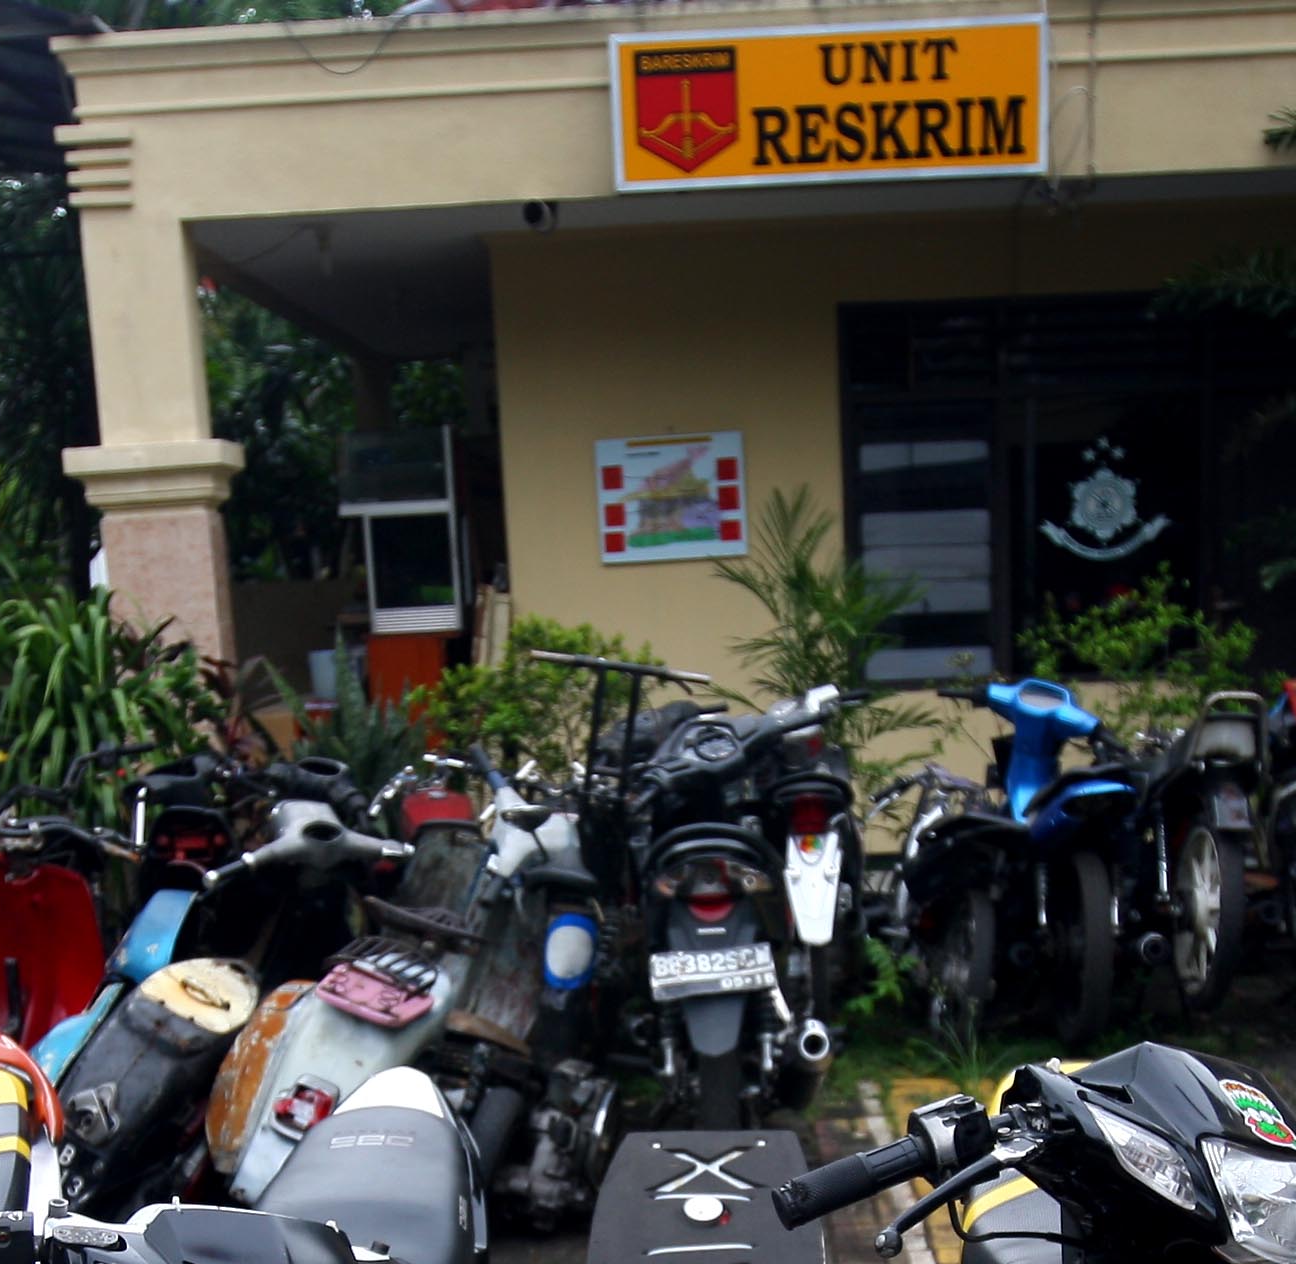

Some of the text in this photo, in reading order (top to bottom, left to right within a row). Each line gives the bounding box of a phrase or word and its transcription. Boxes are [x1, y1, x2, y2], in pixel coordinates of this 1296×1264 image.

[640, 51, 731, 72] BARESKRIM
[819, 38, 958, 85] UNIT
[752, 96, 1027, 165] RESKRIM
